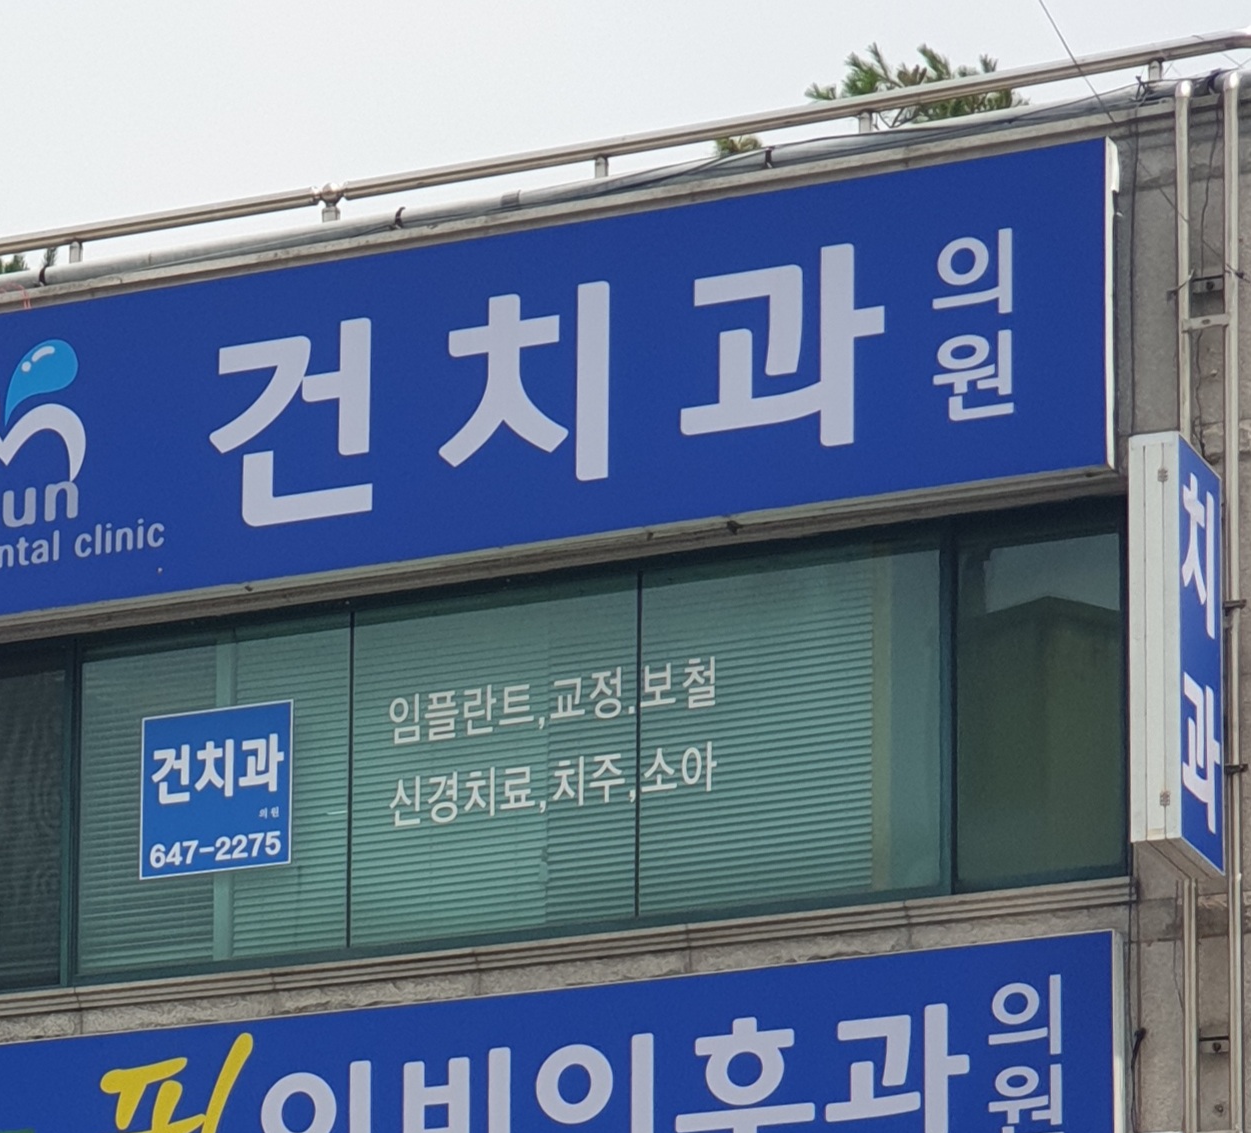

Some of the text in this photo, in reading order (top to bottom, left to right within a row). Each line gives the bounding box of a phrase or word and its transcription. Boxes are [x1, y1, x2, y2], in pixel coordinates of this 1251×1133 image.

[209, 227, 1015, 528] 건치과 의원
[74, 518, 166, 559] clinic
[1182, 472, 1220, 835] 치과
[151, 733, 285, 805] 건치과
[149, 830, 281, 869] 647-2275
